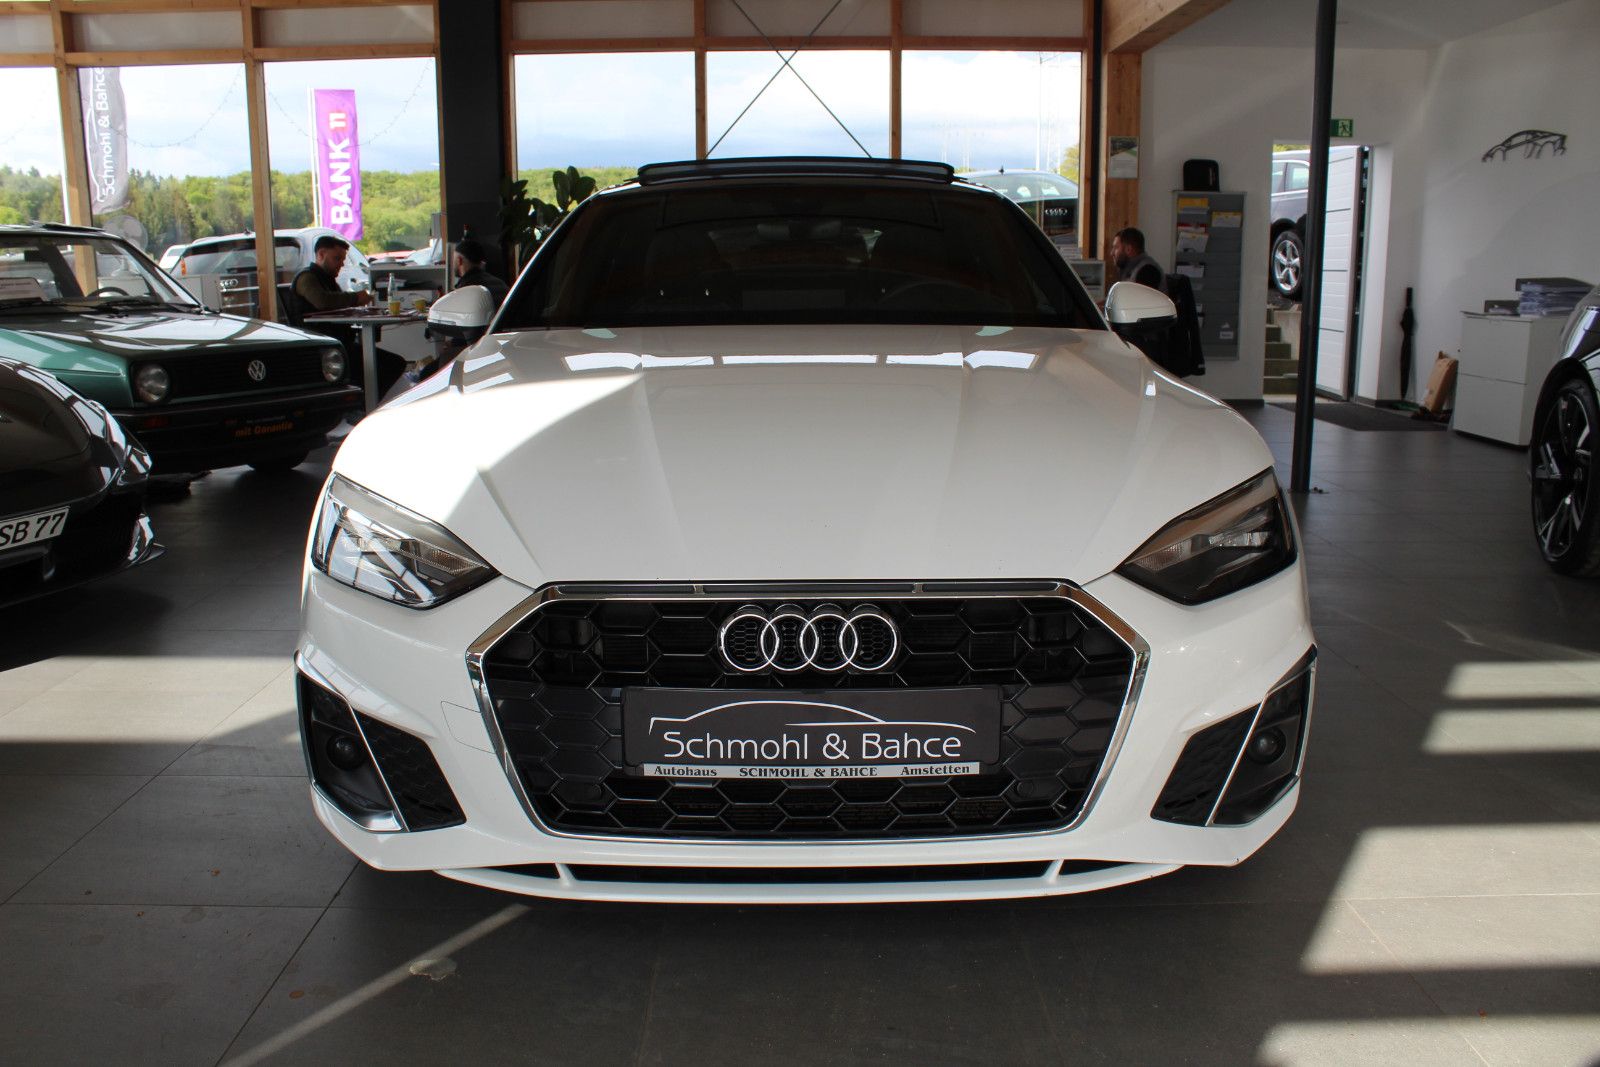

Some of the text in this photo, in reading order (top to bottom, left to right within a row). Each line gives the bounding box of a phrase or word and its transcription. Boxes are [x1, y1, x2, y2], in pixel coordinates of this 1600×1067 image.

[94, 67, 116, 196] Schmohl & Bahce
[328, 112, 354, 225] BANK 11
[35, 512, 66, 539] 77
[663, 731, 962, 760] Schmohl & Bahce
[654, 764, 970, 777] Autohaus SCHMOHL & BAHCE Amstetten
